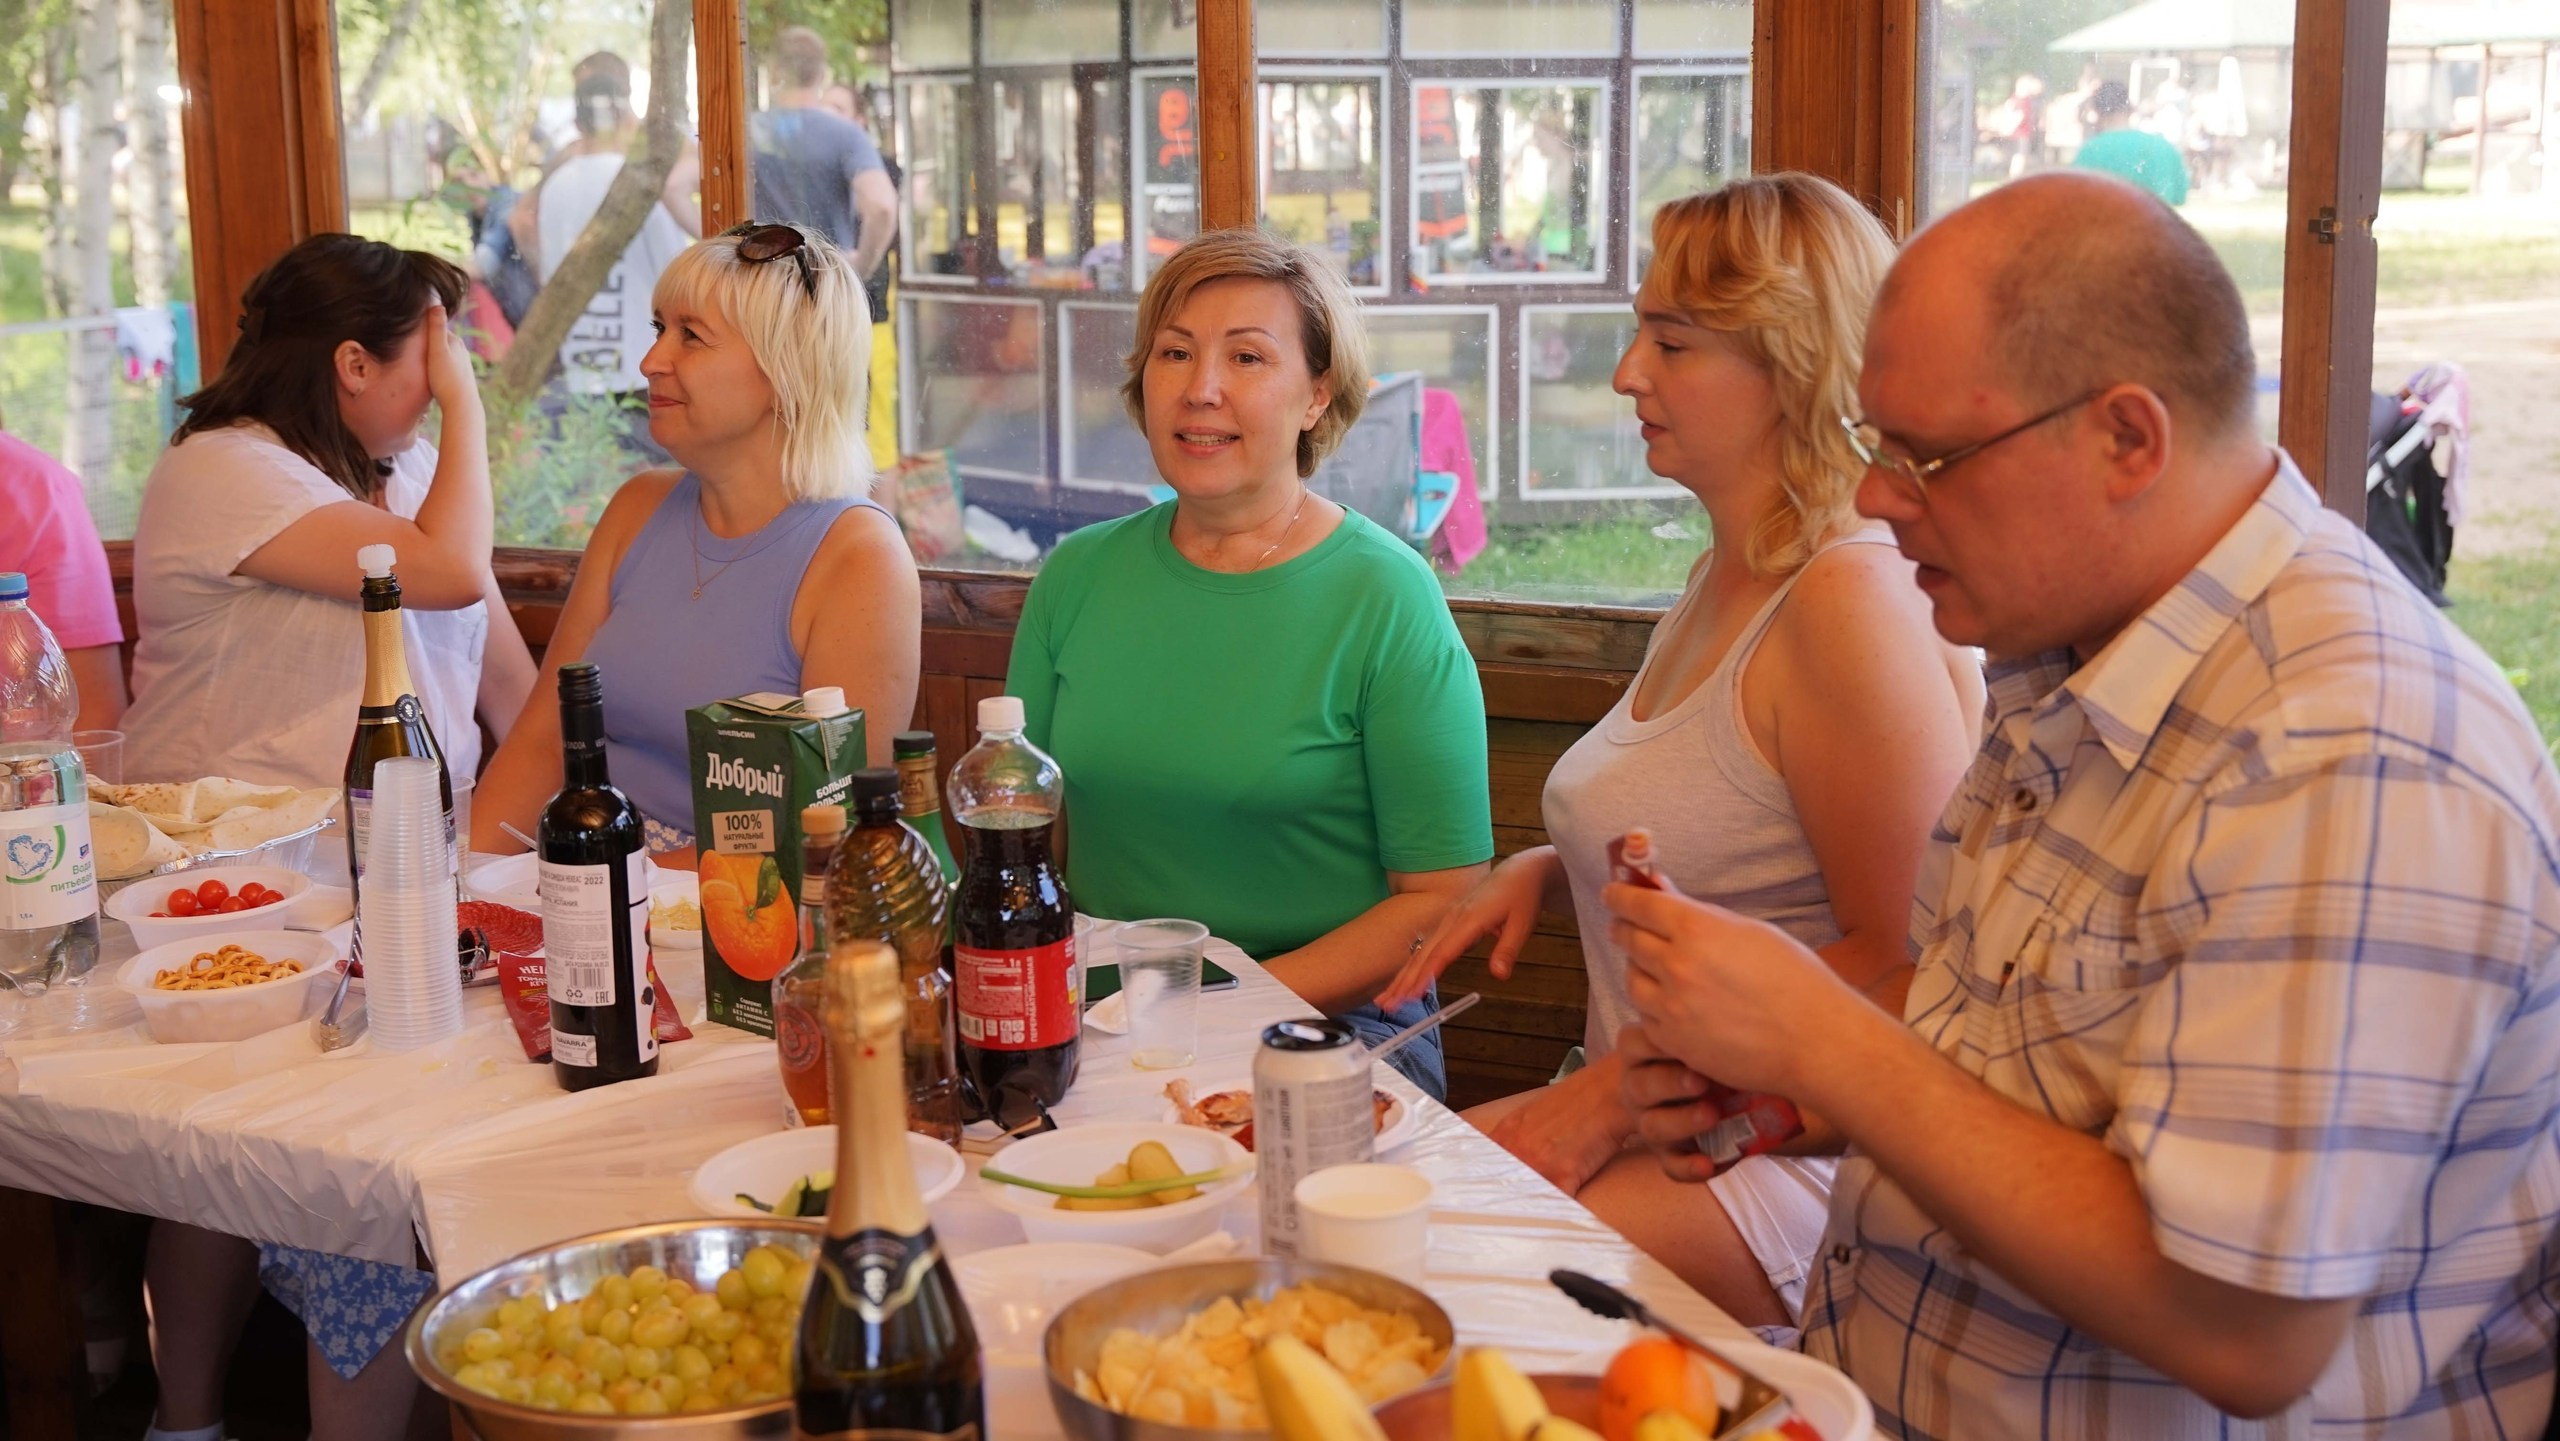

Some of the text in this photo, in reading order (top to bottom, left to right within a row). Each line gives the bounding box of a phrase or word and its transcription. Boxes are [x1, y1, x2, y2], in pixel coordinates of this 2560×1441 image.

[706, 752, 783, 798] Добрый
[725, 813, 762, 831] 100%
[723, 832, 764, 841] НАТУРАЛЬНЫЕ
[733, 842, 757, 850] ФРУКТЫ
[584, 876, 604, 886] 2022
[519, 965, 547, 975] HEI
